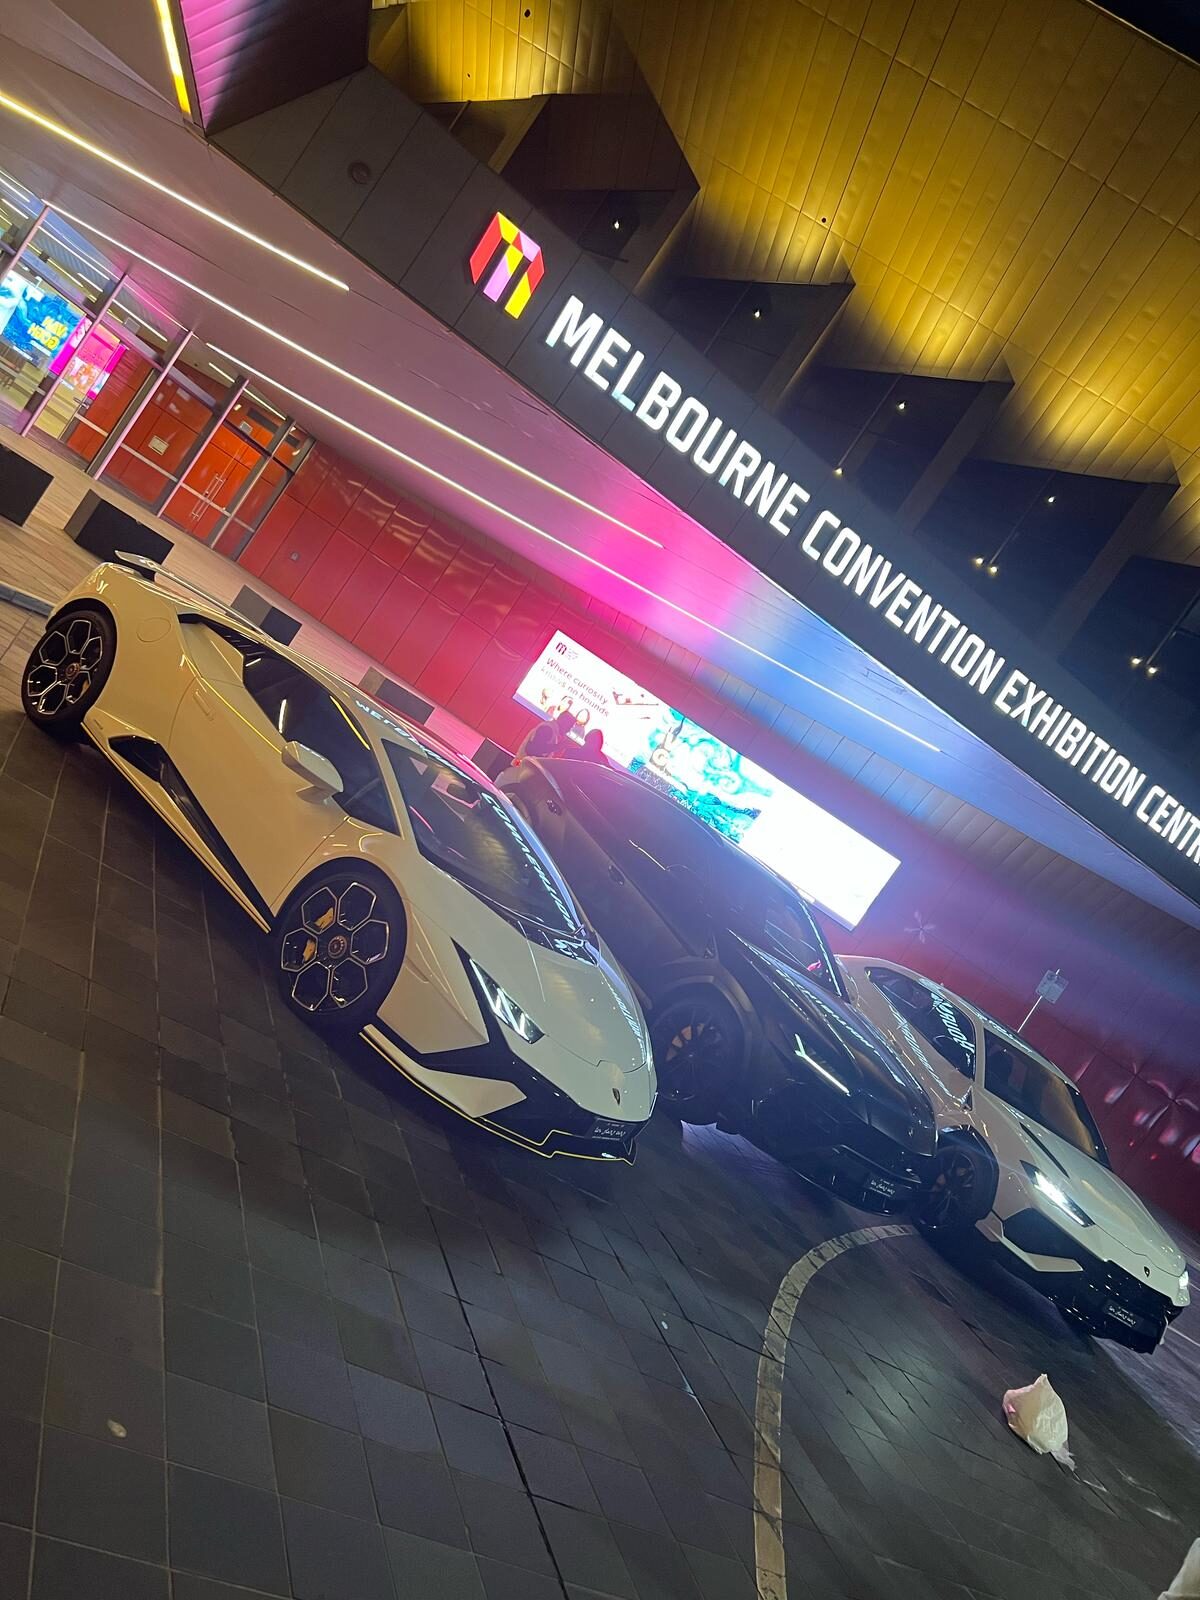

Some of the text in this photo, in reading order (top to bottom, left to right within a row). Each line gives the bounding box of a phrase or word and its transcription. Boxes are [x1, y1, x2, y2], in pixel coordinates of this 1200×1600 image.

[545, 295, 1200, 866] MELBOURNE CONVENTION EXHIBITION CENTR
[546, 657, 608, 705] Where curiosity
[567, 685, 579, 696] no
